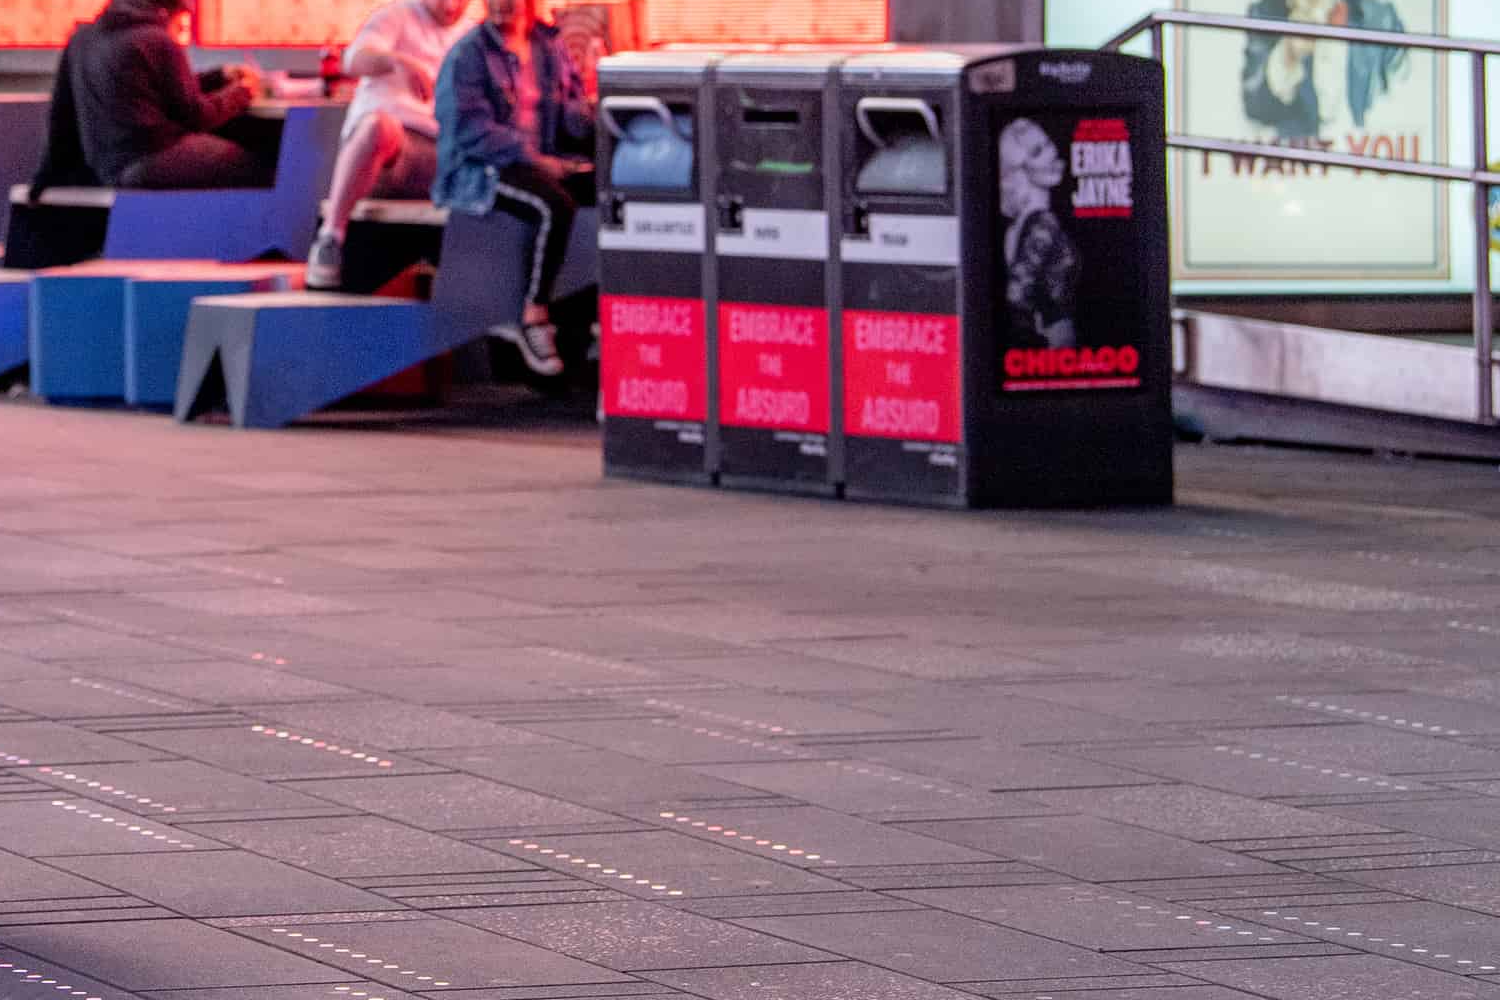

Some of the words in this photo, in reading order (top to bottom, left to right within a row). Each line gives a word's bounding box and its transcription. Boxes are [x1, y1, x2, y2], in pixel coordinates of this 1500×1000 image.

[1070, 141, 1132, 177] ERIKA
[1232, 138, 1333, 177] WANT
[1348, 135, 1419, 177] YOU
[1071, 175, 1133, 207] JAYNE
[611, 302, 693, 337] EMBRACE
[730, 309, 815, 347] EMBRACE
[854, 316, 947, 355] EMBRACE
[1003, 344, 1140, 377] CHICAGO
[617, 378, 688, 415] ABSURD
[735, 387, 810, 425] ABSURD
[861, 396, 940, 436] ABSURD
